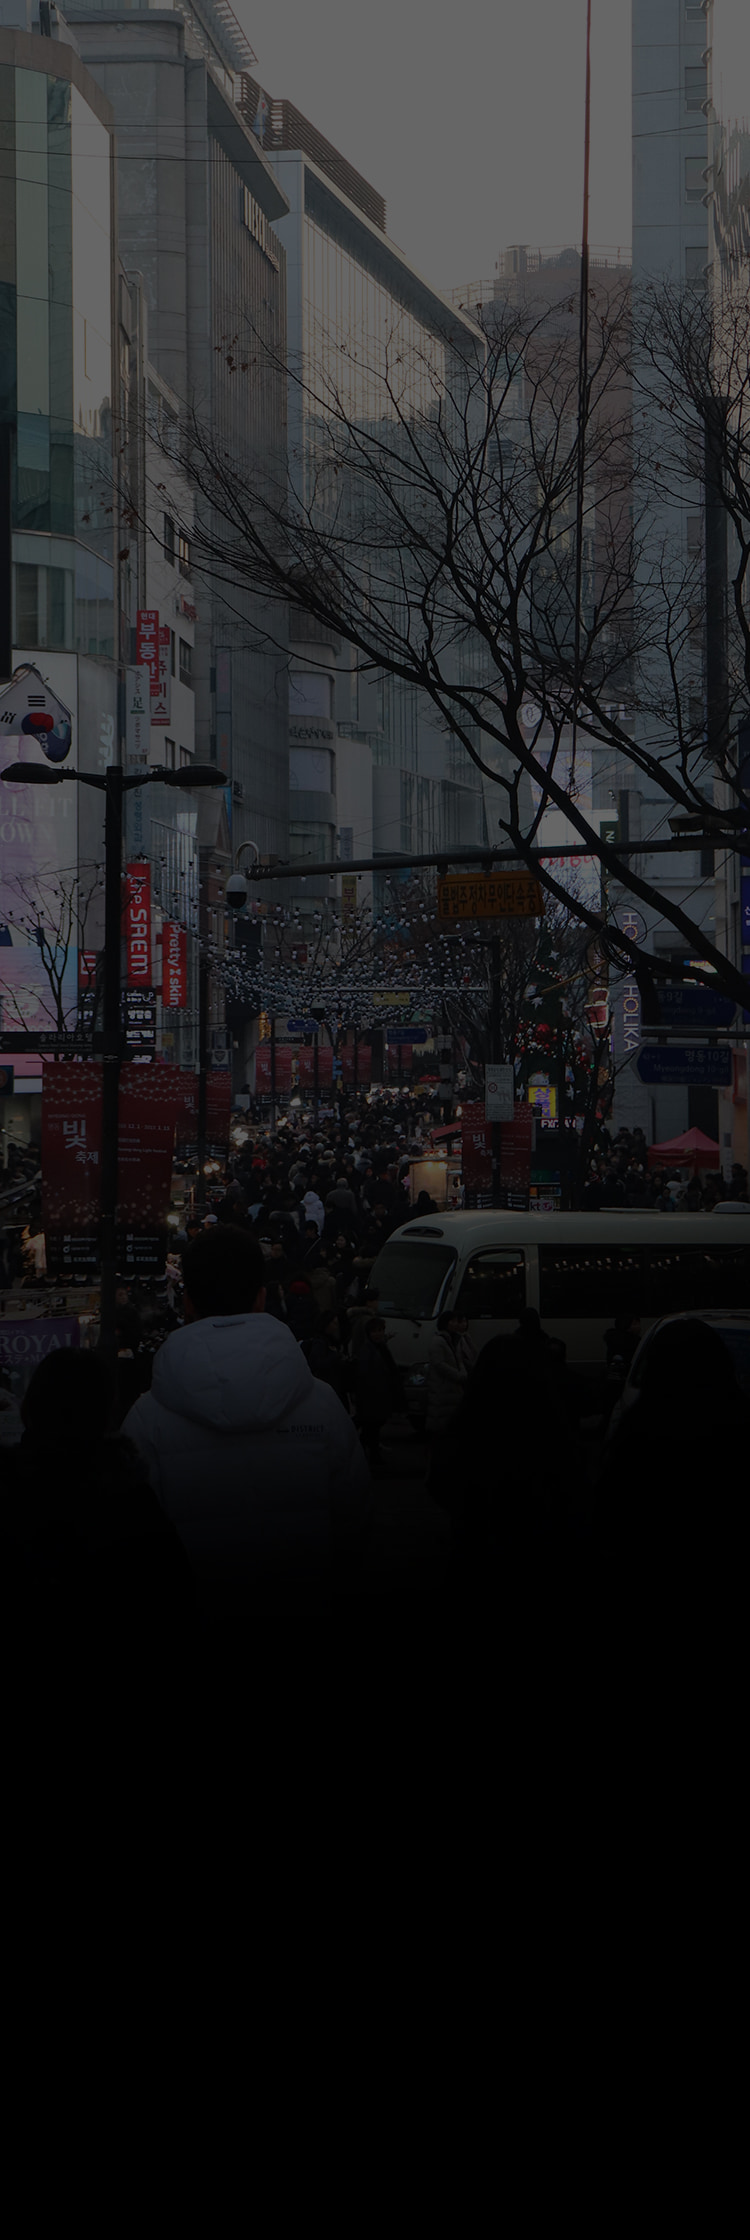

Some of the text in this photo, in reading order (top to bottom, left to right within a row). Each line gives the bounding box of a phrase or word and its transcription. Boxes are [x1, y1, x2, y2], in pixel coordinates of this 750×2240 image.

[129, 877, 147, 904] the
[166, 924, 183, 1006] Pretty skin
[623, 984, 640, 1052] HOLIKA
[684, 1049, 730, 1064] 명동10길
[653, 1063, 705, 1073] Myeongdong
[62, 1119, 87, 1150] 빛
[75, 1150, 99, 1165] 축제
[530, 1199, 541, 1212] kt
